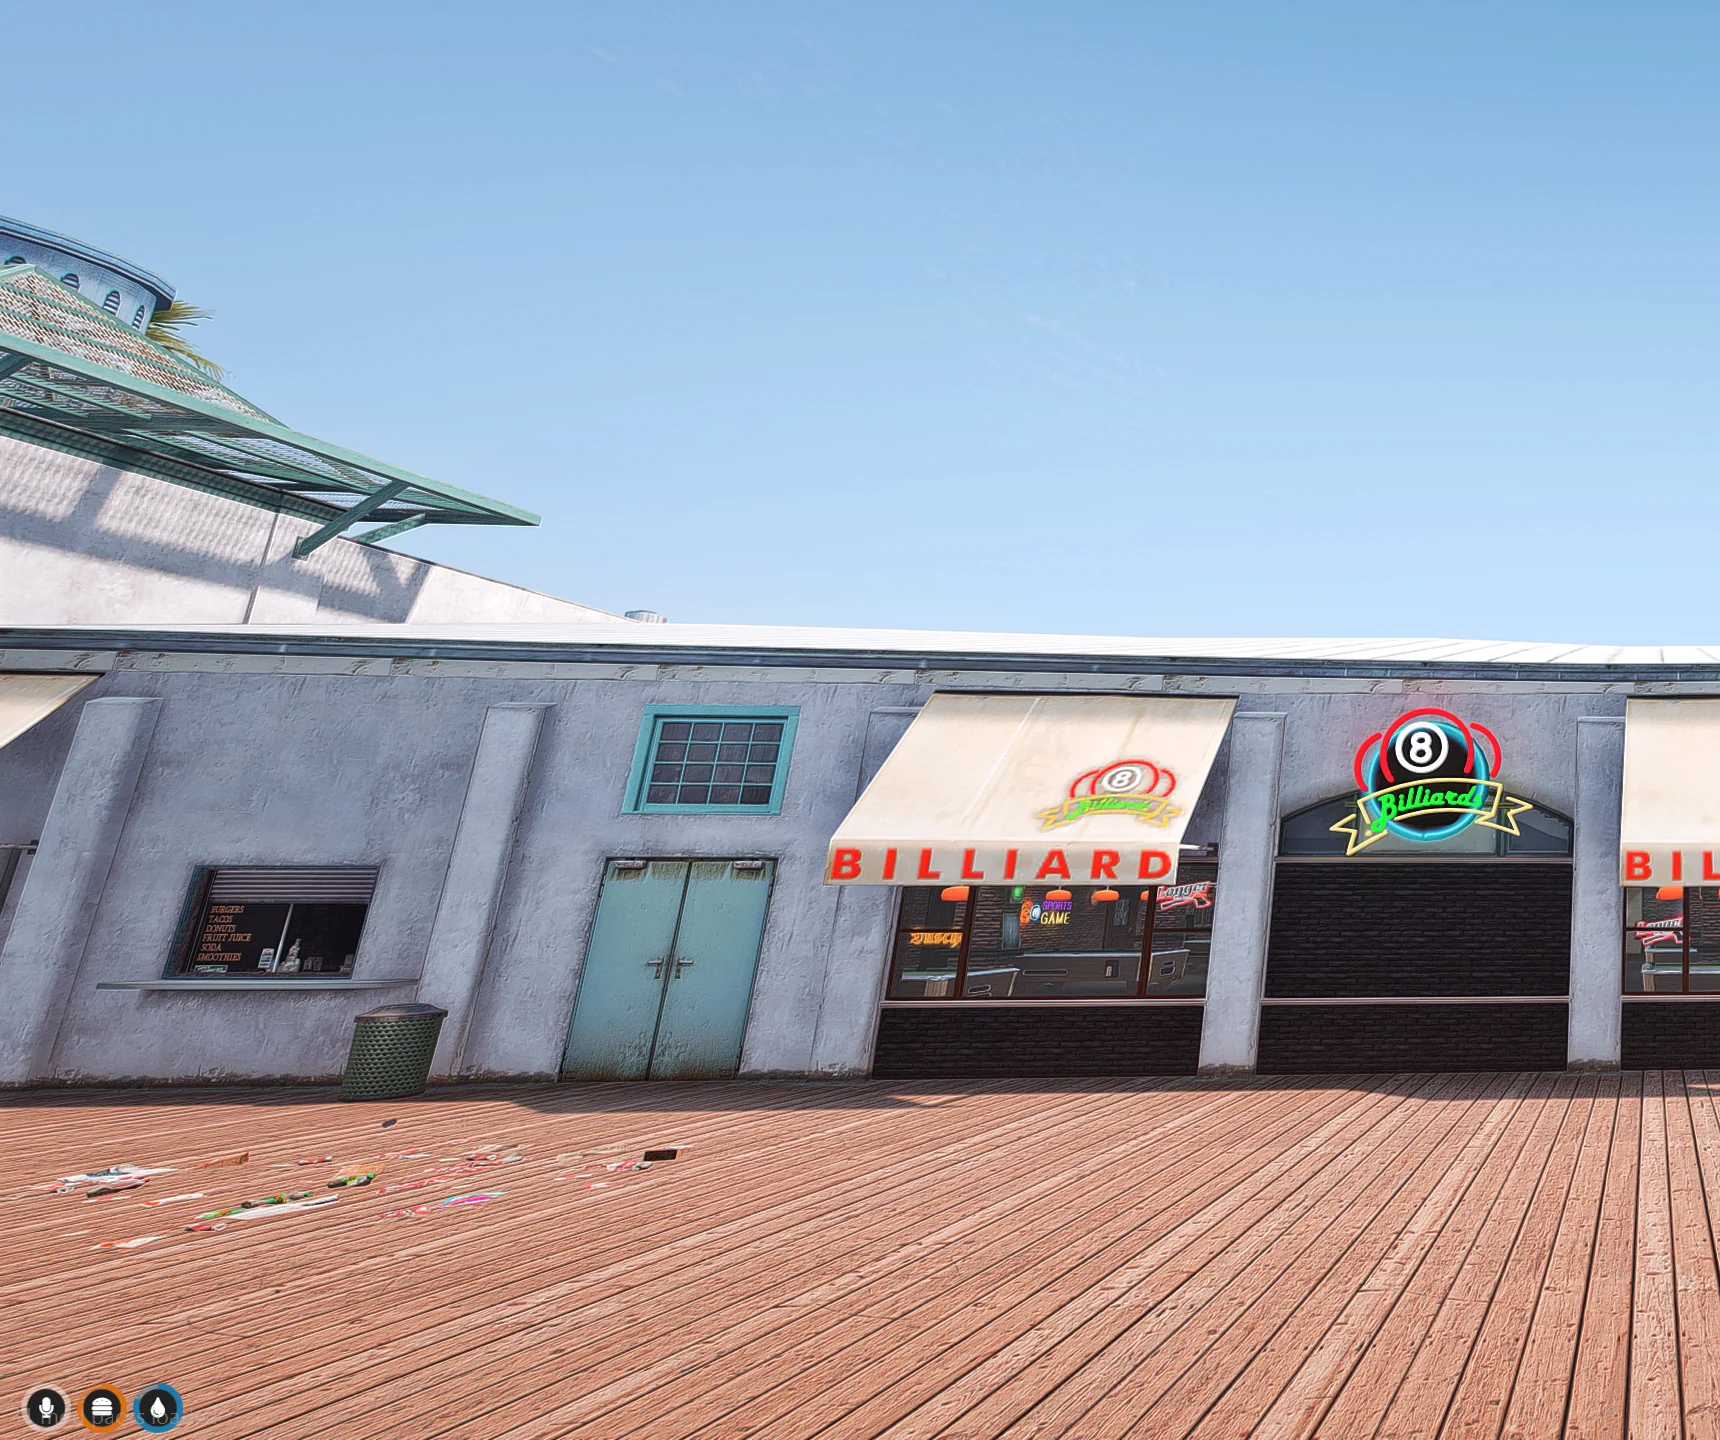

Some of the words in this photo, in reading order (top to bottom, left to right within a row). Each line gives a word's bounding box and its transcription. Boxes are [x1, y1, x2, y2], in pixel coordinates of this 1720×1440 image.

[1409, 731, 1433, 764] 8
[1111, 771, 1131, 787] 8
[1370, 785, 1482, 833] Billiards
[830, 847, 1173, 881] BILLIARD
[210, 905, 245, 914] BURGERS
[1042, 900, 1073, 911] SPORTS
[208, 915, 233, 923] TACOS
[1040, 911, 1071, 925] GAME
[205, 924, 237, 932] DONUTS
[202, 933, 228, 942] FRUIT
[228, 933, 252, 942] JUICE
[200, 943, 222, 951] SODA
[197, 953, 242, 962] SMOOTHIES
